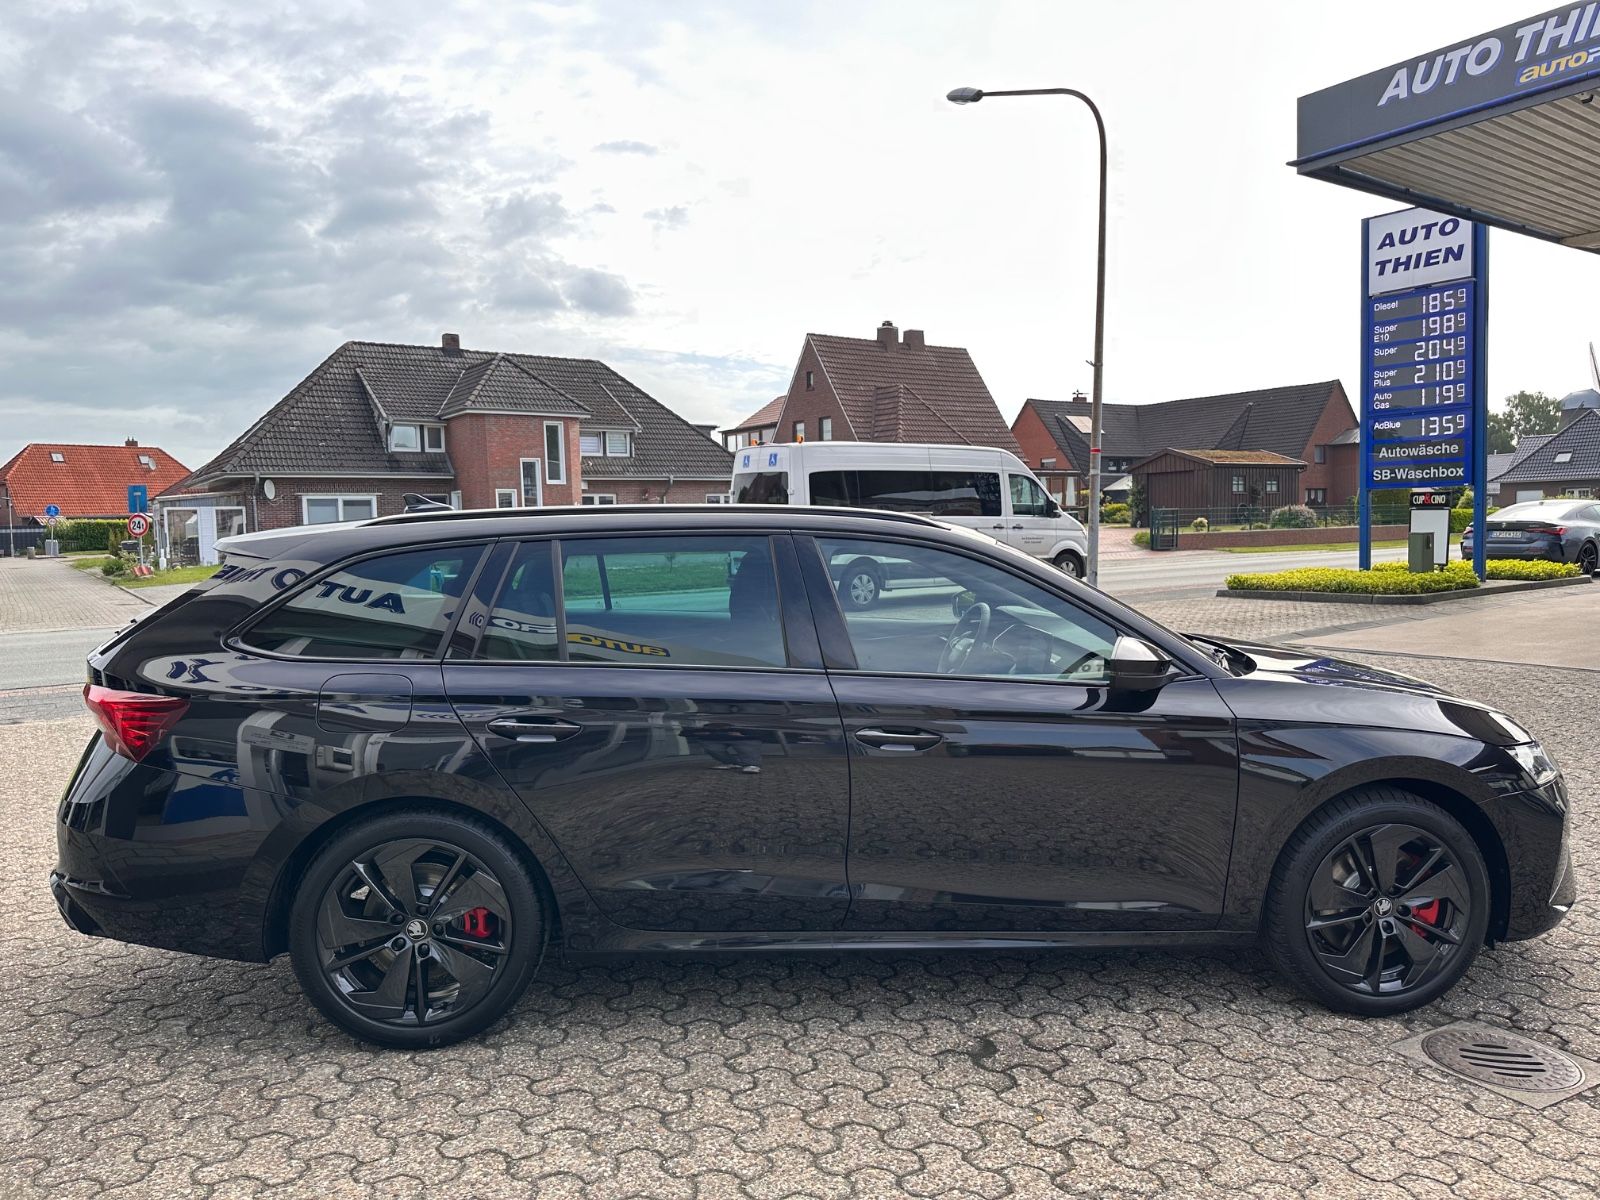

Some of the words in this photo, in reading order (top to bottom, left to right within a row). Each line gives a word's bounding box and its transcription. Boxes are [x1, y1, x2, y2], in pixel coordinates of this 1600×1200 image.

[1377, 37, 1503, 106] AUTO
[1377, 218, 1460, 250] AUTO
[1375, 244, 1464, 276] THIEN
[1374, 300, 1399, 311] Diesel
[1374, 324, 1398, 334] Super
[1373, 334, 1390, 343] E10
[1374, 347, 1398, 356] Super
[1374, 370, 1397, 379] Super
[1373, 379, 1391, 388] Plus
[1373, 393, 1392, 401] Auto
[1373, 401, 1390, 409] Gas
[1373, 421, 1401, 430] AdBlue
[1379, 443, 1459, 459] Autowäsche
[1373, 466, 1465, 481] SB-Waschbox
